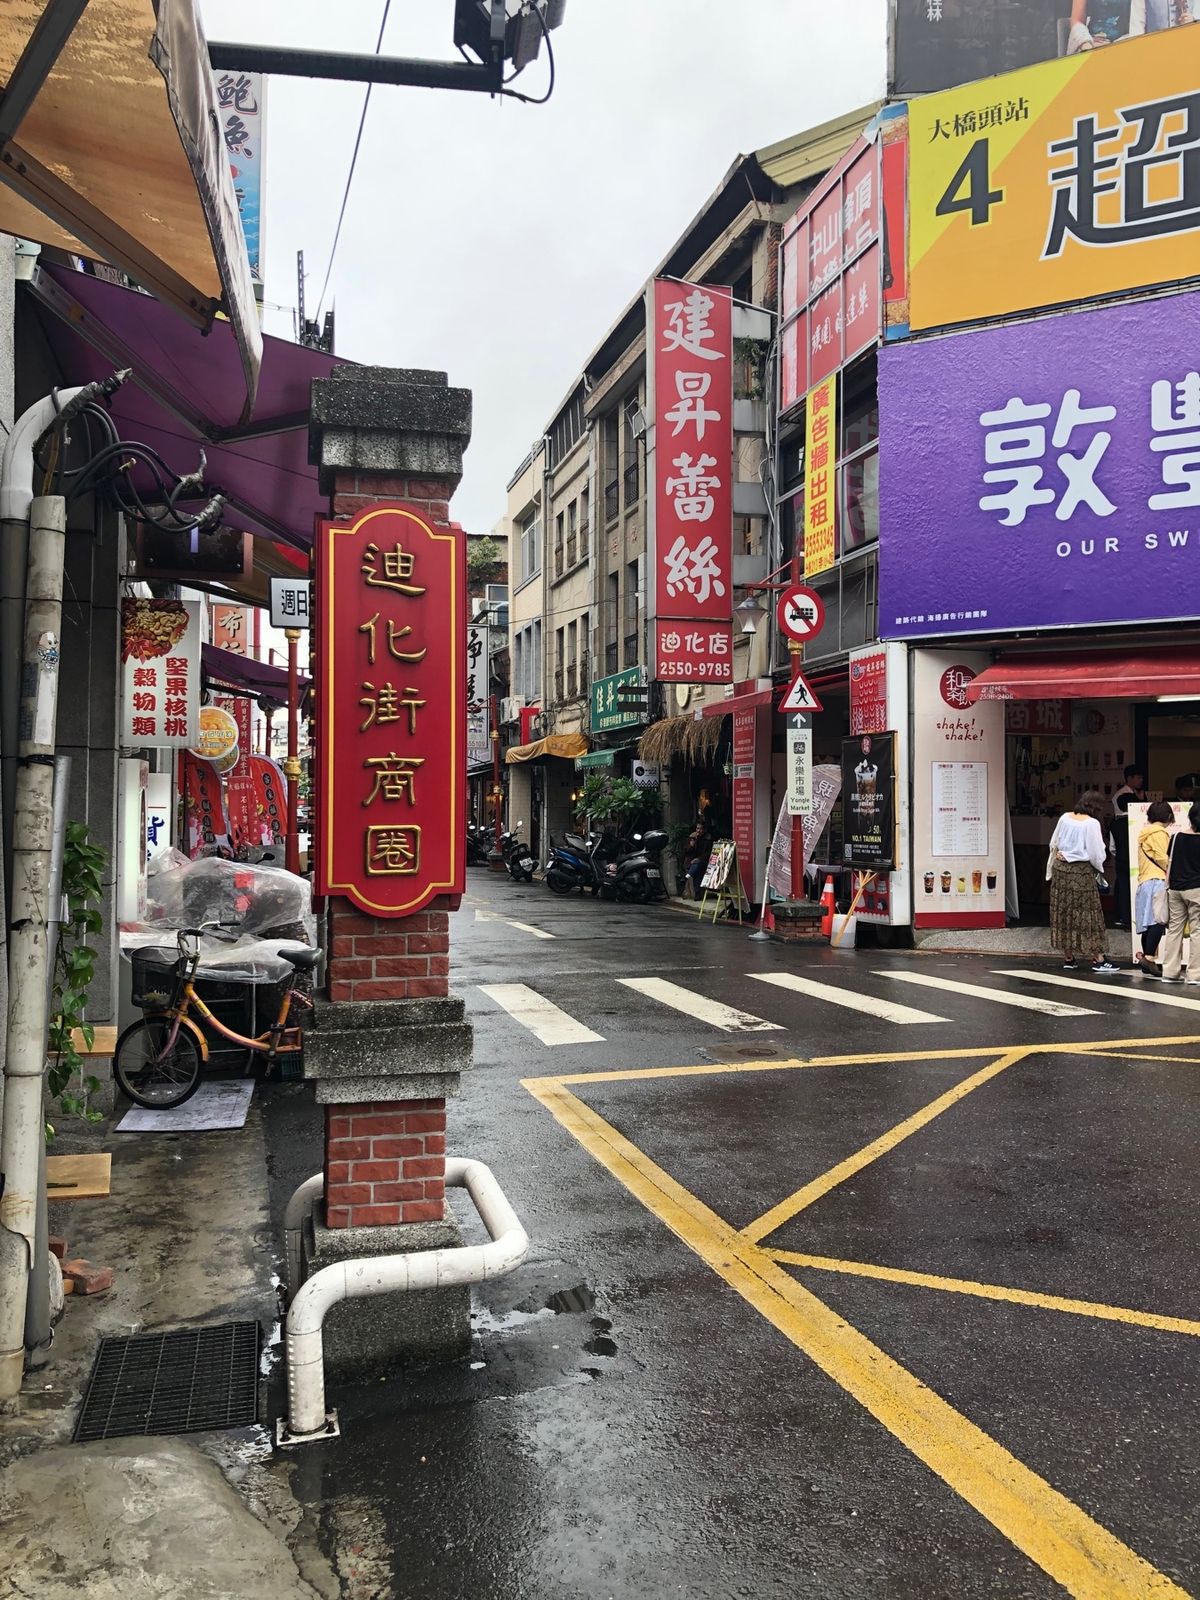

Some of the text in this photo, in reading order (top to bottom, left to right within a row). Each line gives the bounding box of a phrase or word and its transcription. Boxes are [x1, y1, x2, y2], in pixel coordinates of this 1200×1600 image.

[928, 97, 1029, 144] 大橋頭站
[935, 137, 1003, 226] 4
[661, 289, 727, 604] 建昇蕾絲
[809, 385, 831, 530] 廣告牆出租
[1056, 536, 1120, 557] OUR
[660, 632, 729, 655] 迪化店
[660, 661, 731, 677] 2550-9785
[132, 668, 157, 737] 穀物類
[164, 657, 189, 737] 堅果核桃
[360, 542, 428, 876] 迪化街商圈
[936, 718, 976, 731] shake!
[945, 729, 984, 741] shake!
[795, 755, 805, 796] 永樂市場
